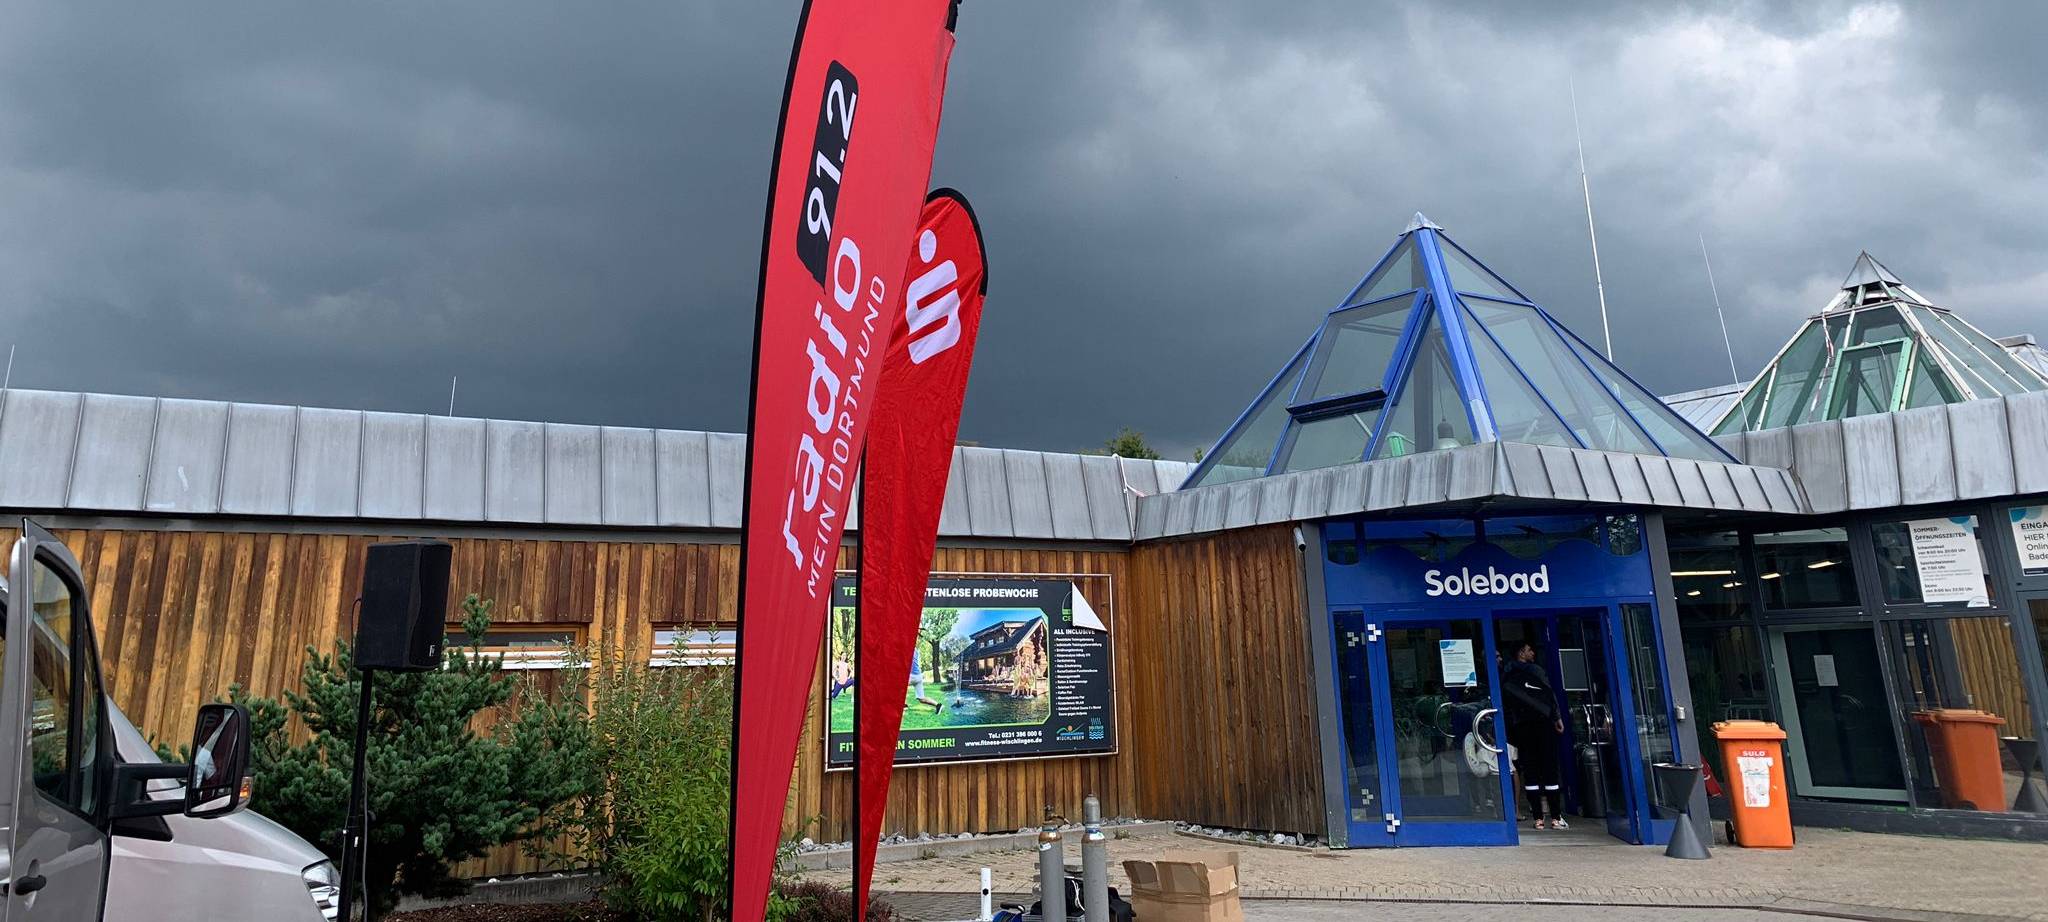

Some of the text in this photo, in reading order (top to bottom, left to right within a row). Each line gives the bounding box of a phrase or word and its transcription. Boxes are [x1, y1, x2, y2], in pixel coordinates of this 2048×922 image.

[807, 79, 857, 242] 91.2
[783, 237, 862, 570] radio
[807, 275, 886, 599] MEIN DORTMUND
[2021, 521, 2048, 529] EINGA
[926, 587, 972, 598] TENLOSE
[973, 587, 1039, 598] PROBEWOCHE
[1424, 564, 1550, 597] Solebad
[907, 737, 956, 750] SOMMER!
